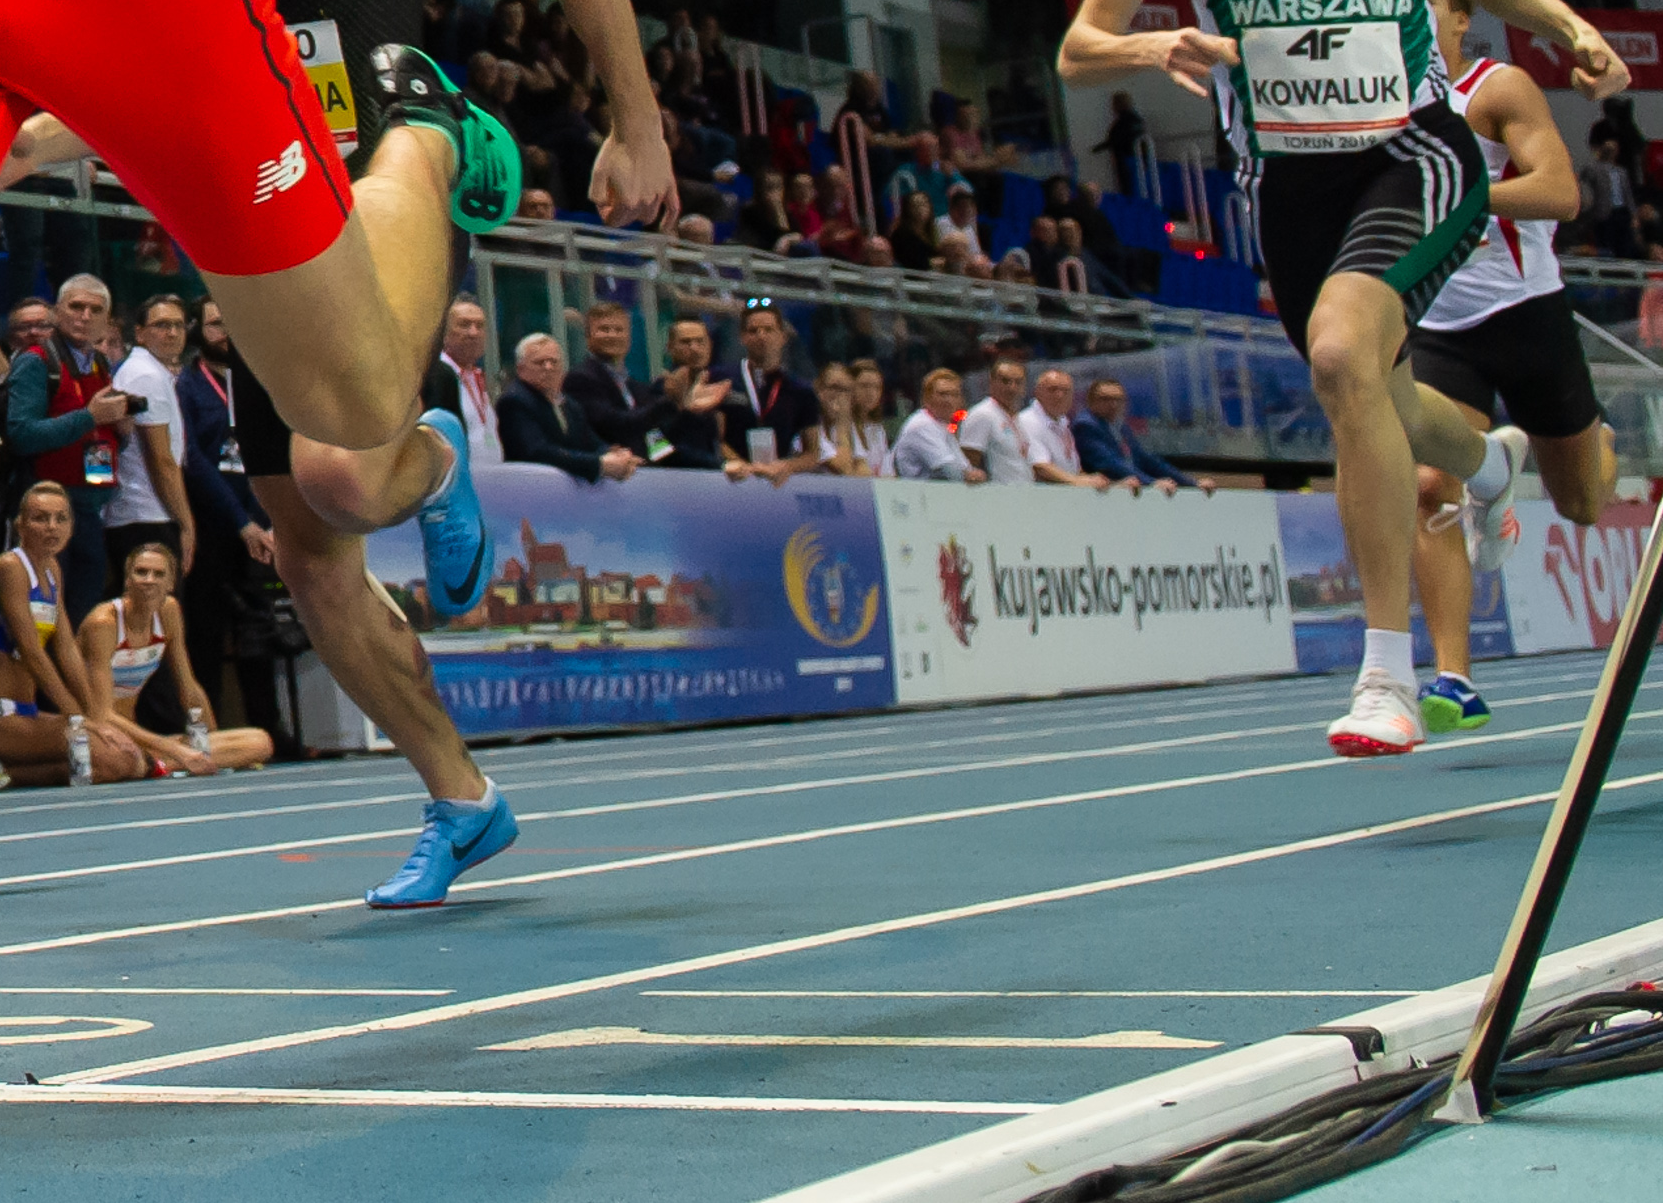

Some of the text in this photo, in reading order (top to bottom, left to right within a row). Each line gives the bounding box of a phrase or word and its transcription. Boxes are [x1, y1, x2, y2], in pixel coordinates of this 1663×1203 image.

[1286, 27, 1352, 61] 4F
[1252, 75, 1401, 106] KOWALUK
[1338, 134, 1377, 149] 2019
[988, 544, 1283, 635] kujawsko-pomorskie.pl
